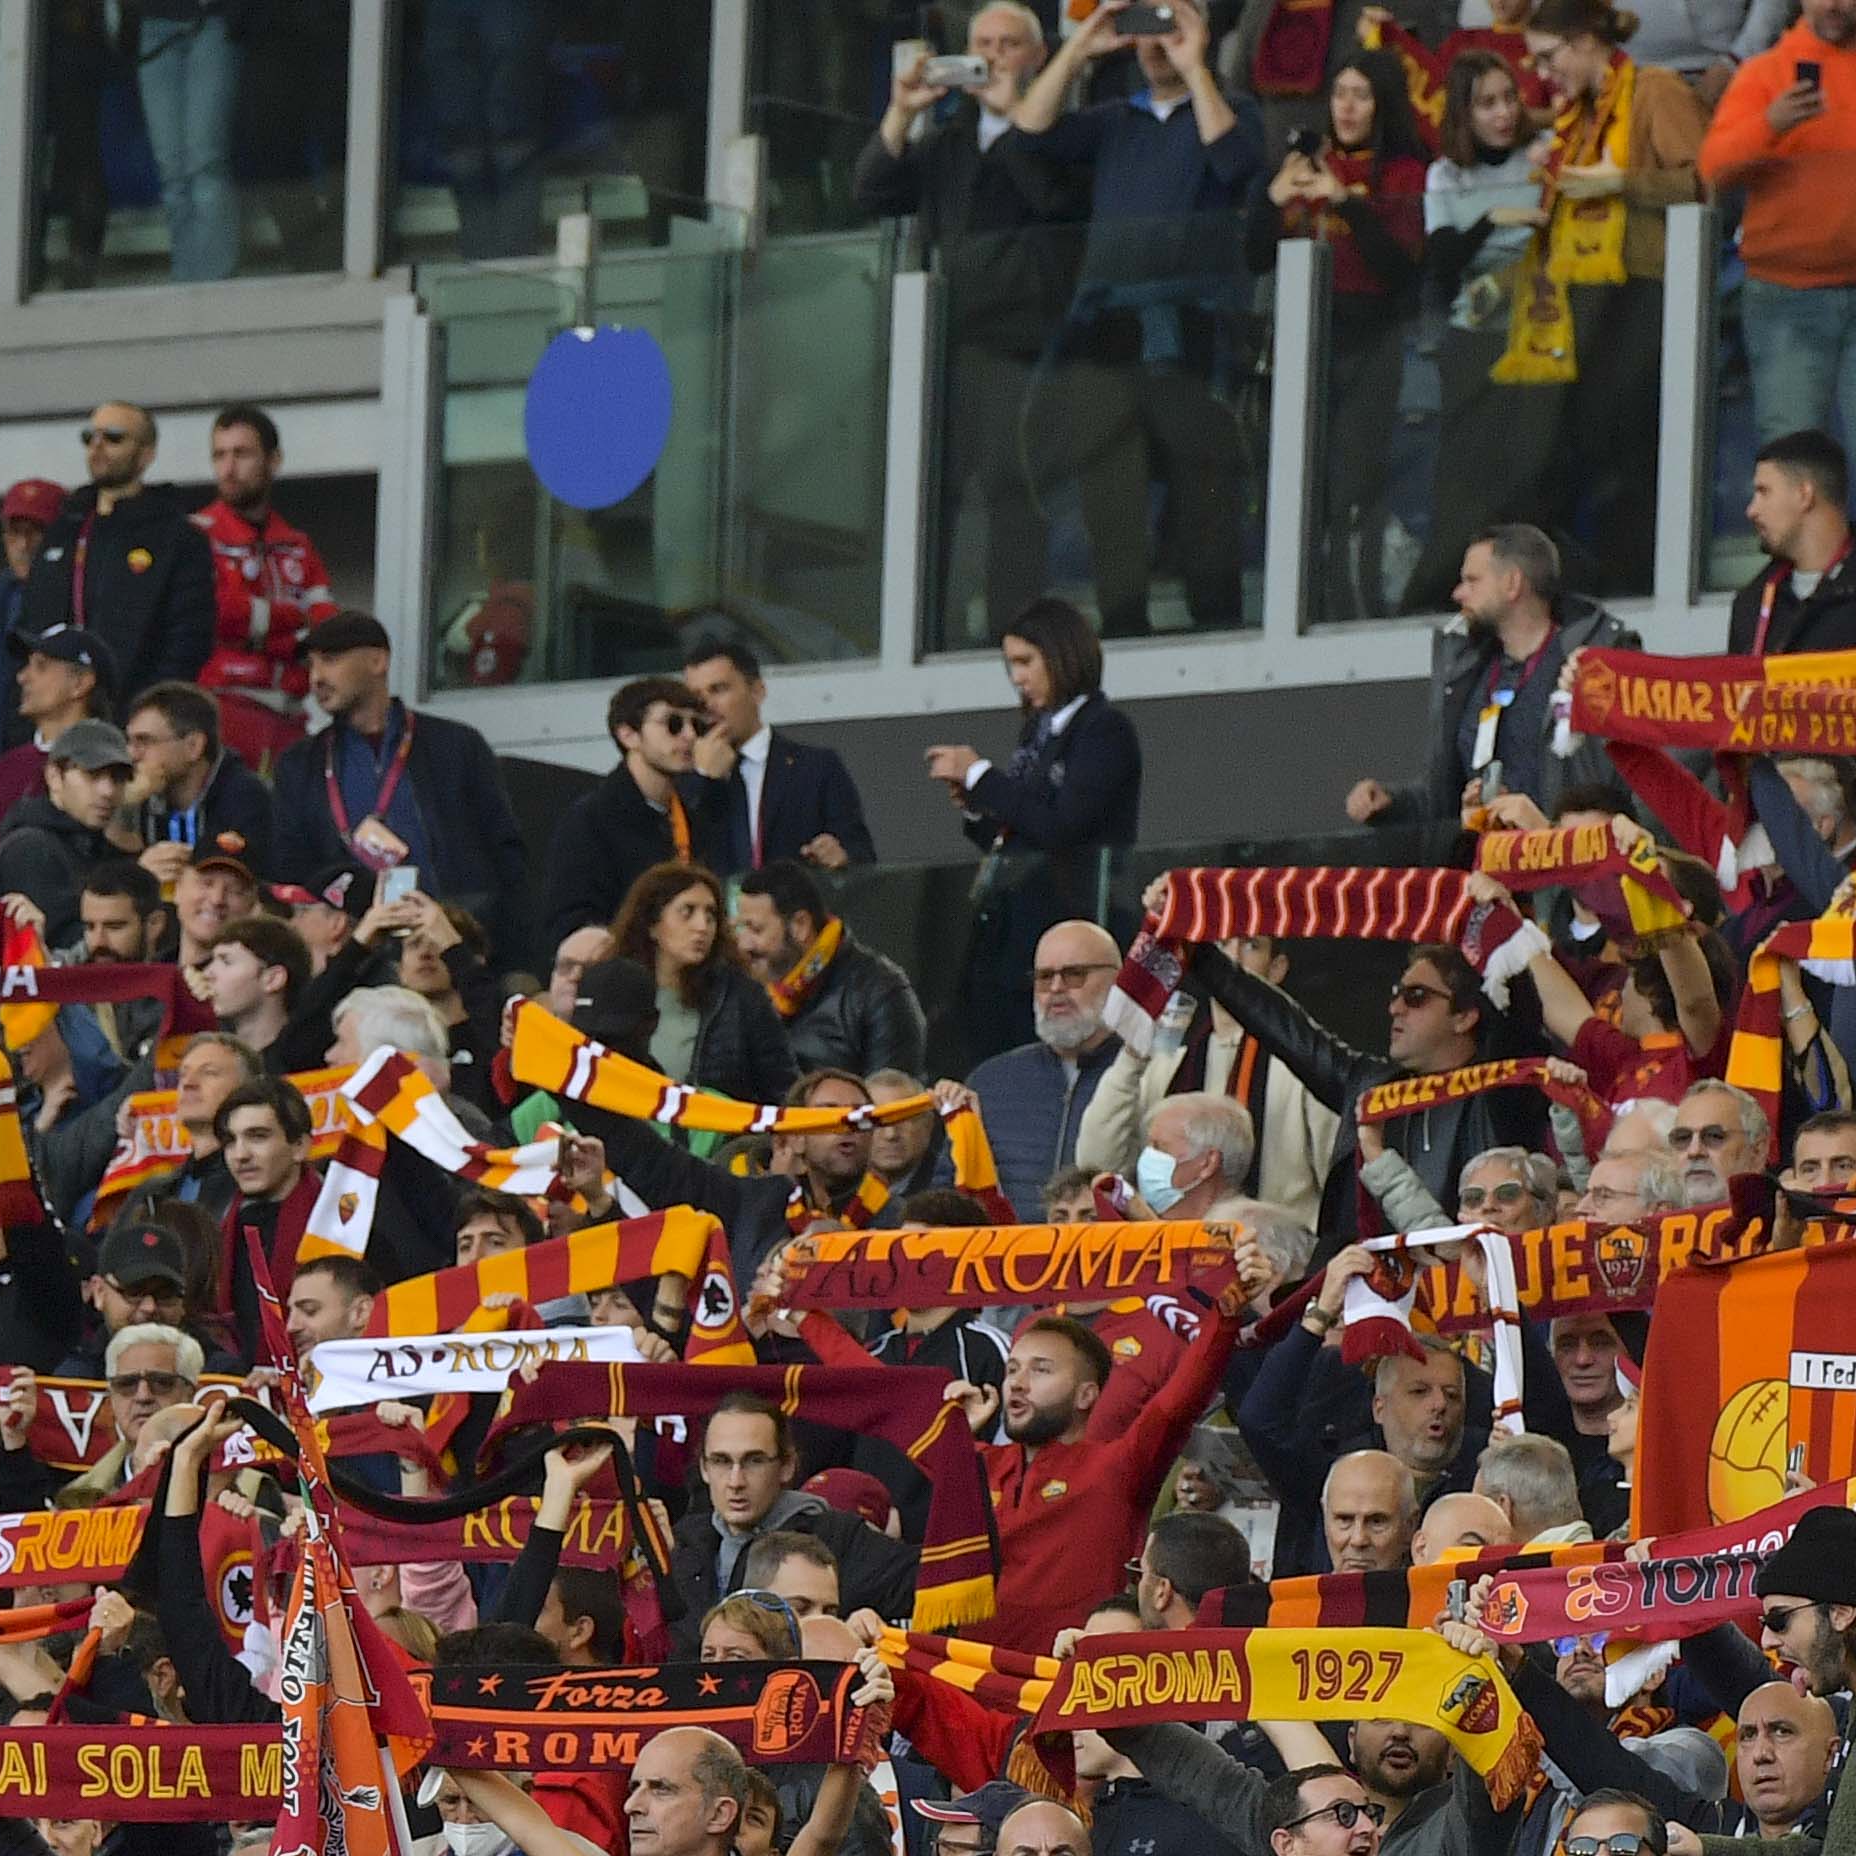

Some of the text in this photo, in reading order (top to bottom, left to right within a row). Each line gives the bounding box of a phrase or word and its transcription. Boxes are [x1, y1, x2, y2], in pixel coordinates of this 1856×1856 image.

[948, 1222, 1176, 1297] ROMA
[1603, 1259, 1642, 1277] 1927
[1804, 1360, 1811, 1382] I
[525, 1666, 670, 1713] Forza
[1058, 1648, 1405, 1717] ASROMA 1927
[80, 1743, 211, 1799] SOLA
[493, 1730, 642, 1765] ROM
